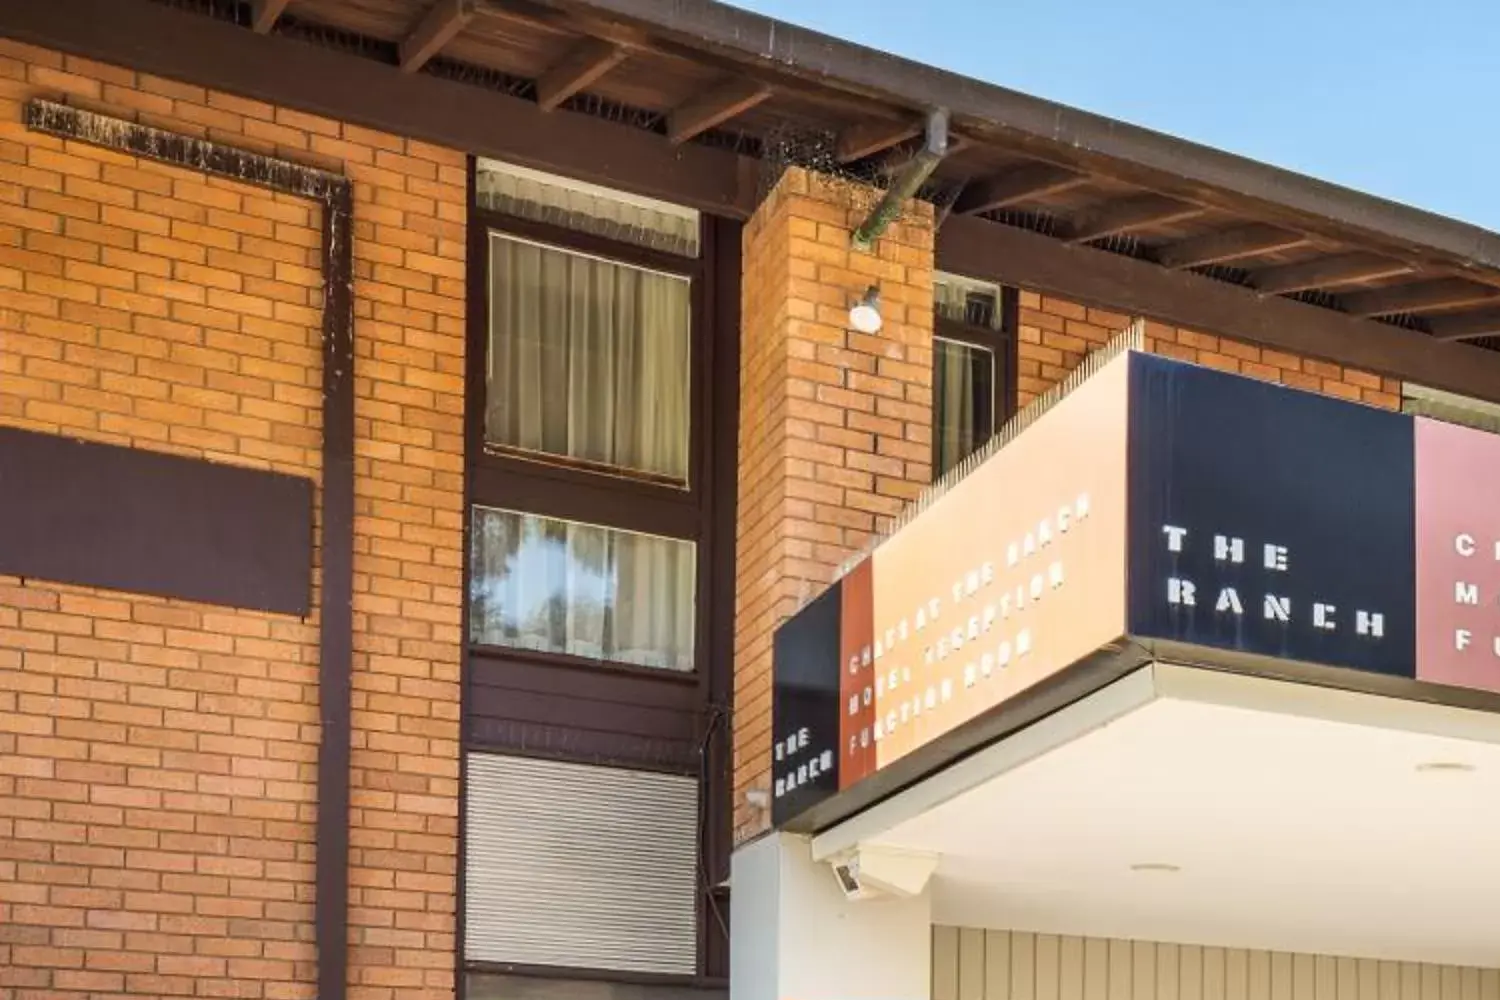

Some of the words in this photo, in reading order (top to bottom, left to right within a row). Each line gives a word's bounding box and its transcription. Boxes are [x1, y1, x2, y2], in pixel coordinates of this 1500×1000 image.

[1162, 524, 1288, 571] THE
[1167, 577, 1384, 637] RANCH
[849, 618, 908, 675] CHATS
[775, 727, 811, 761] THE
[775, 750, 833, 798] RANCH
